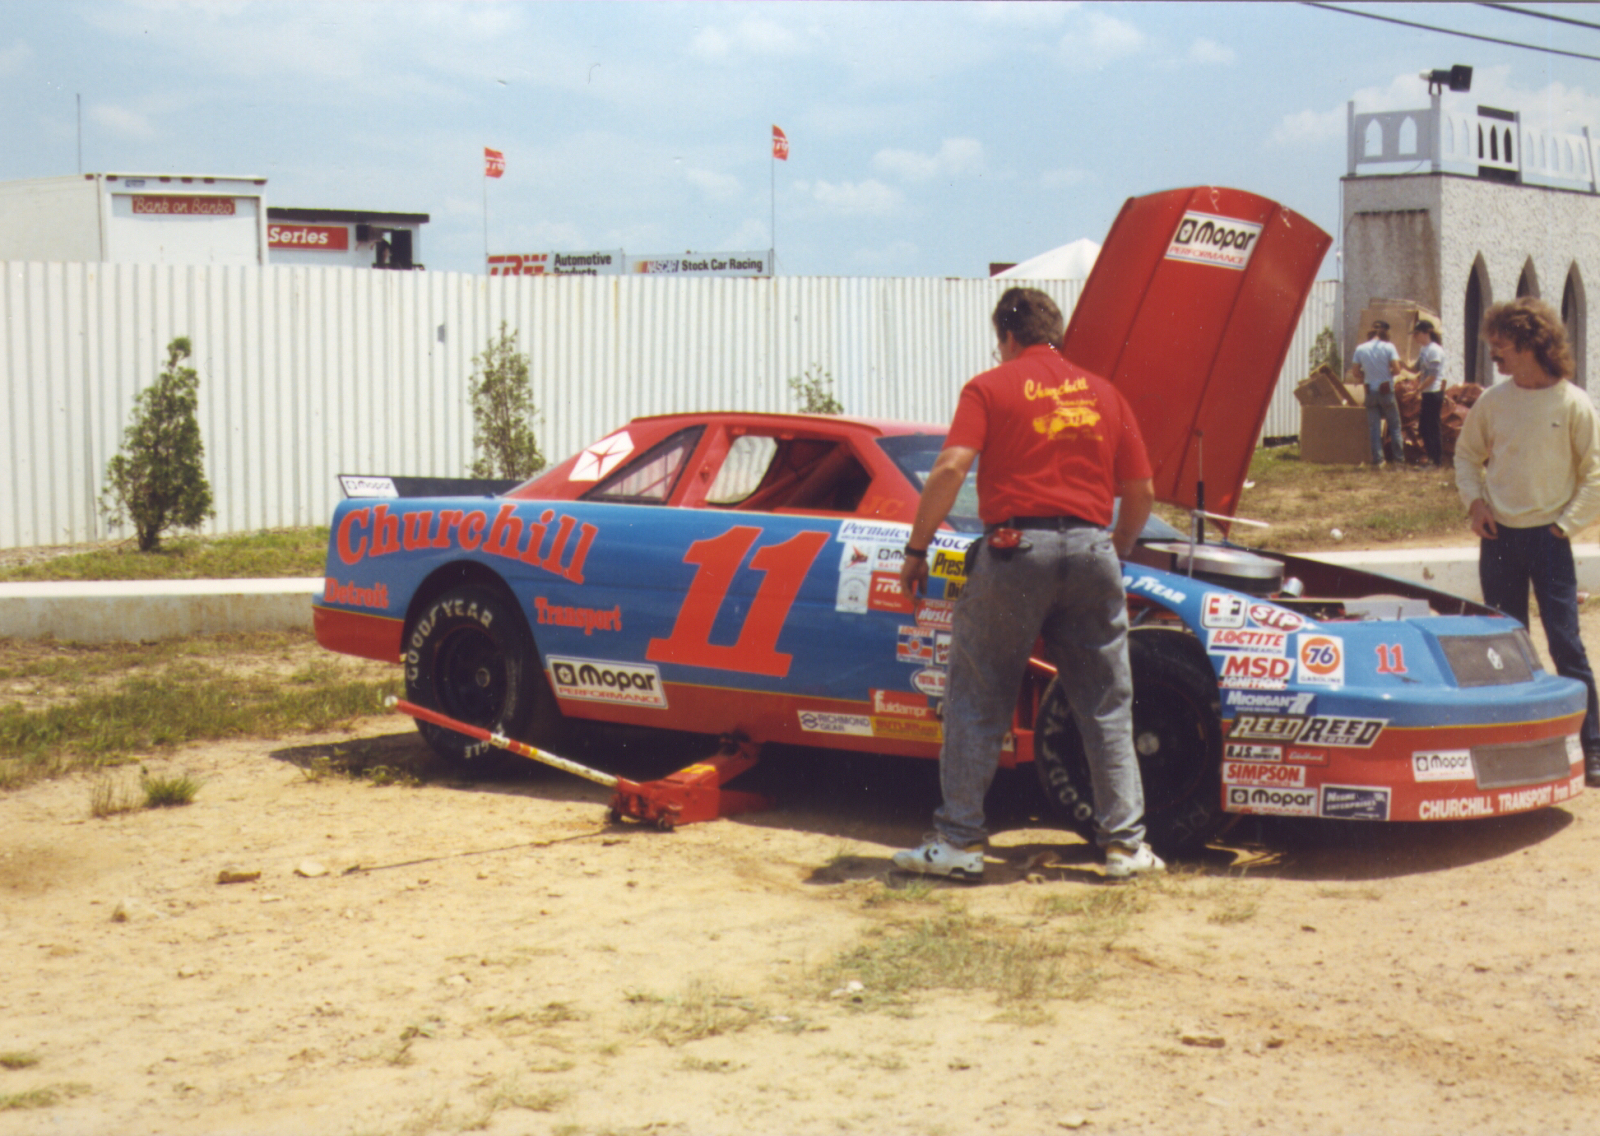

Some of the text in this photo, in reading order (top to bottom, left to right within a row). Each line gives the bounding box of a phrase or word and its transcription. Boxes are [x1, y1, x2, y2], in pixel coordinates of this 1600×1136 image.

[173, 202, 188, 213] on
[268, 227, 329, 245] Series
[1195, 220, 1256, 251] Mopar
[487, 253, 612, 276] TRW Automotive
[681, 259, 709, 271] Stock
[711, 259, 727, 271] Car
[729, 257, 763, 272] Racing
[1169, 247, 1245, 265] PERFORMANCE
[337, 503, 599, 585] Churchill
[324, 577, 389, 609] Detroit
[645, 524, 832, 678] 11
[534, 596, 622, 636] Transport
[1252, 605, 1300, 628] STP
[406, 599, 494, 681] GOODYEAR
[1212, 629, 1284, 647] LOCTITE
[1239, 646, 1283, 655] RESEARCH
[1306, 646, 1335, 665] 76
[1375, 643, 1407, 674] 11
[1224, 655, 1290, 678] MSD
[578, 663, 656, 692] Mopar
[1223, 677, 1285, 689] IGNITION
[558, 686, 663, 705] PERFORMANCE
[1288, 692, 1316, 714] 77
[818, 714, 870, 727] RICHMOND
[820, 723, 845, 731] GEAR
[1229, 716, 1385, 746] REED REED
[1430, 754, 1468, 769] Mopar
[1227, 763, 1301, 781] SIMPSON
[1252, 788, 1314, 807] Mopar
[1419, 796, 1494, 820] CHURCHILL
[1498, 785, 1552, 813] TRANSPORT
